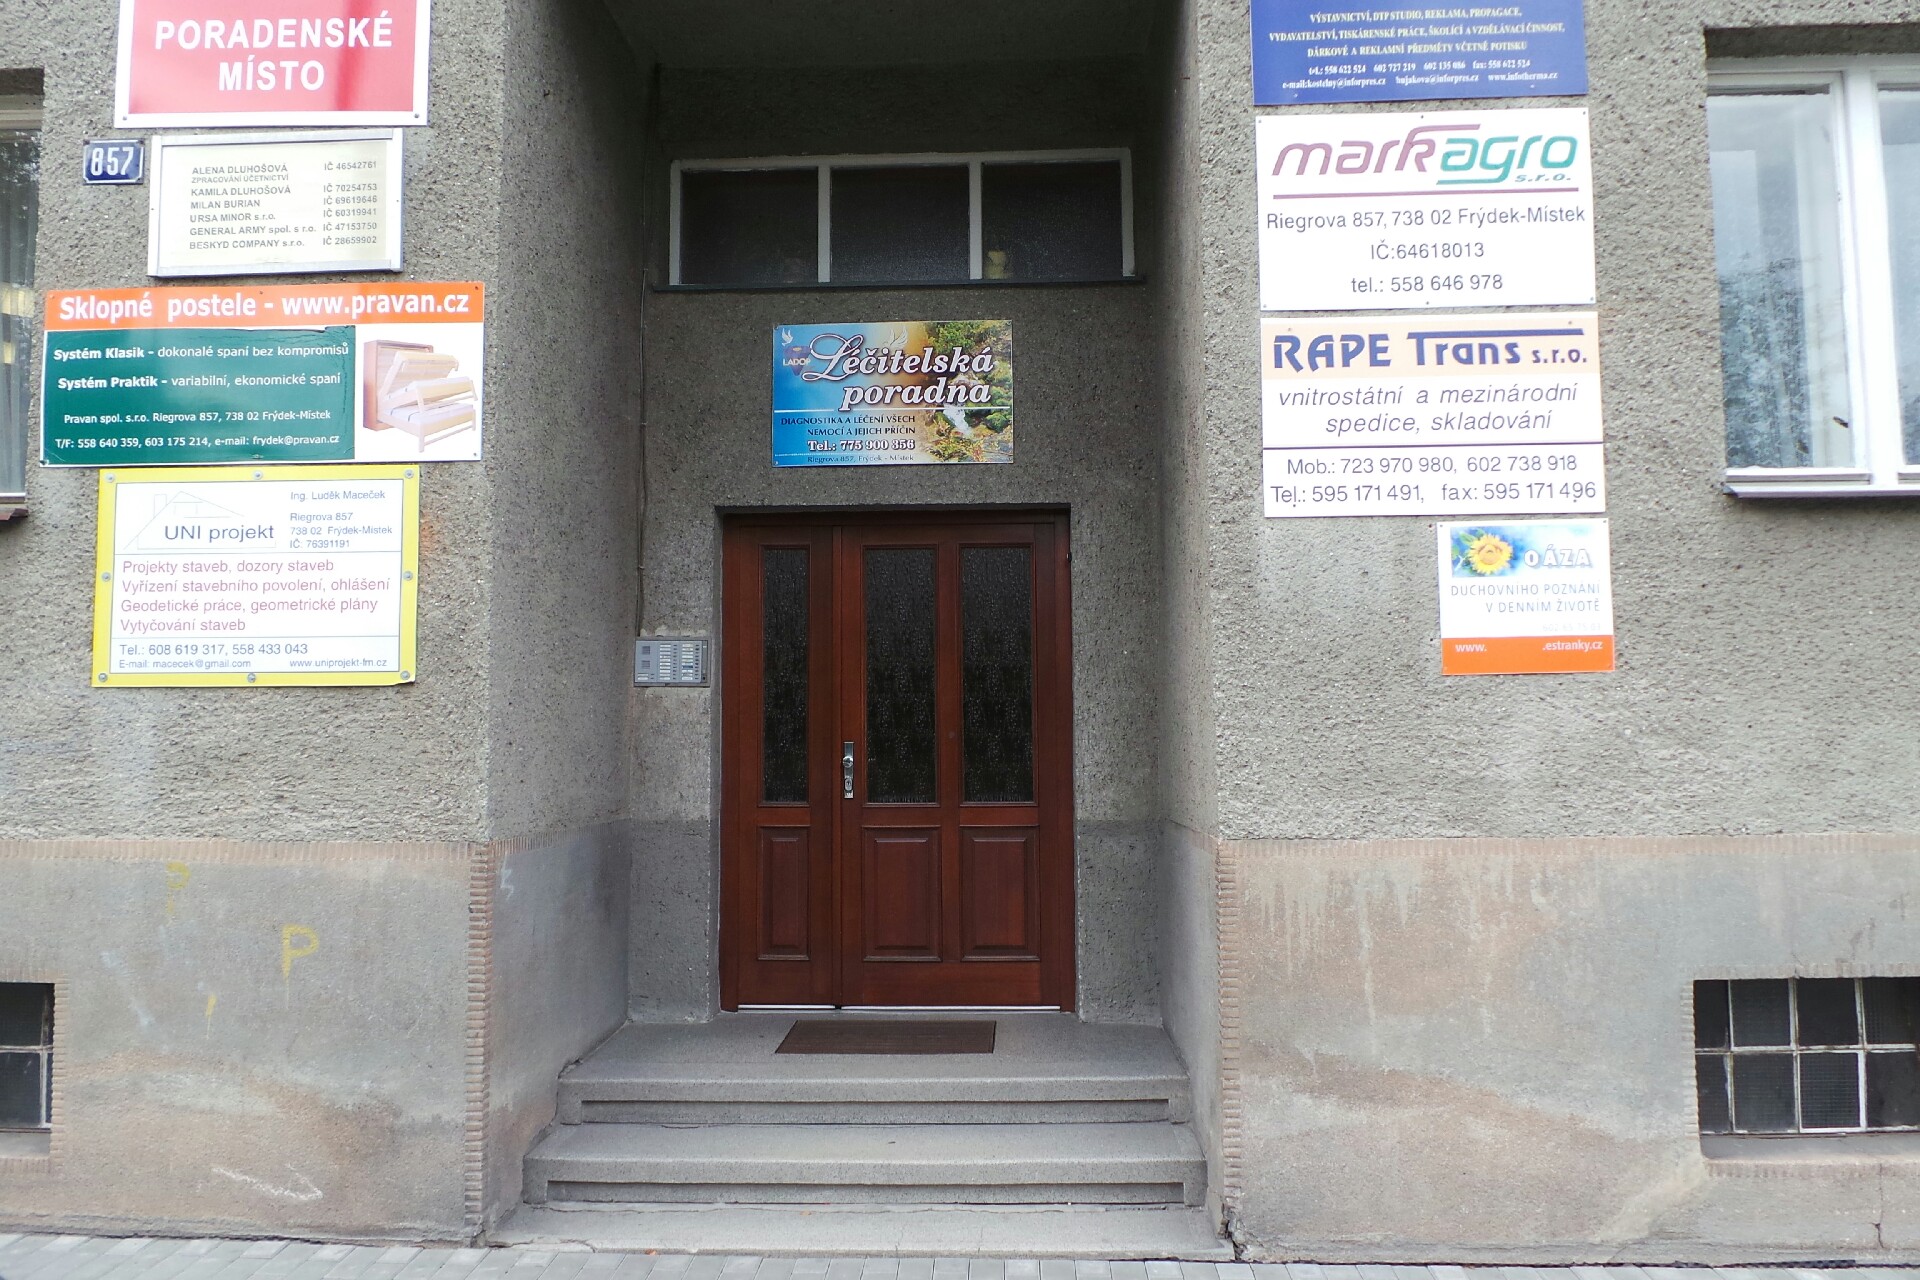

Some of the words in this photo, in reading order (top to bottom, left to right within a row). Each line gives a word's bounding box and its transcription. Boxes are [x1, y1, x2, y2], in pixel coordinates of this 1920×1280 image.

[155, 11, 393, 50] PORADENSKÉ
[218, 55, 325, 91] MÍSTO
[90, 147, 133, 176] 857
[192, 166, 224, 174] ALENA
[228, 163, 287, 173] DLUHOŠOVÁ
[324, 162, 333, 171] IČ
[1515, 174, 1571, 183] s.r.o.
[191, 188, 228, 196] KAMILA
[230, 185, 290, 195] DLUHOŠOVÁ
[324, 185, 333, 193] IČ
[191, 201, 221, 209] MILAN
[224, 200, 260, 208] BURIAN
[324, 197, 333, 205] IČ
[190, 215, 218, 223] URSA
[220, 213, 251, 221] MINOR
[323, 209, 333, 218] IČ
[1267, 212, 1346, 233] Riegrova
[1353, 211, 1387, 229] 857,
[1392, 210, 1424, 227] 738
[1431, 209, 1451, 225] 02
[1458, 206, 1585, 228] Frýdek-Místek
[190, 227, 236, 235] GENERAL
[239, 226, 266, 234] ARMY
[269, 226, 291, 234] spol.
[323, 223, 332, 231] IČ
[190, 241, 229, 249] BESKYD
[232, 240, 280, 248] COMPANY
[323, 237, 332, 245] IČ
[1371, 239, 1484, 260] IČ:64618013
[1352, 276, 1383, 293] tel.:
[1391, 276, 1424, 292] 558
[1431, 275, 1463, 291] 646
[1470, 274, 1503, 290] 978
[59, 292, 152, 320] Sklopné
[168, 288, 256, 321] postele
[282, 293, 469, 319] www.pravan.cz
[54, 347, 101, 363] Systém
[105, 346, 145, 358] Klasik
[158, 345, 213, 358] dokonalé
[217, 345, 249, 361] spaní
[253, 345, 273, 357] bez
[277, 342, 348, 359] kompromisů
[802, 334, 993, 381] Léčitelská
[1274, 333, 1391, 373] RAPE
[1407, 328, 1521, 366] Trans
[1532, 348, 1588, 364] s.r.o.
[58, 376, 106, 391] Systém
[110, 375, 157, 388] Praktik
[171, 374, 231, 388] variabilní,
[235, 372, 305, 387] ekonomické
[309, 373, 341, 388] spaní
[839, 377, 991, 411] poradna
[1279, 387, 1402, 406] vnitrostátní
[1417, 390, 1428, 404] a
[1439, 383, 1578, 403] mezinárodní
[64, 414, 97, 424] Pravan
[100, 412, 122, 426] spol.
[153, 411, 196, 424] Riegrova
[200, 412, 222, 424] 857,
[225, 412, 242, 422] 738
[246, 411, 259, 421] 02
[262, 408, 330, 423] Frýdek-Místek
[781, 417, 843, 425] DIAGNOSTIKA
[854, 415, 884, 423] LÉČENÍ
[887, 415, 915, 423] VŠECH
[1326, 414, 1421, 437] spedice,
[1431, 410, 1552, 431] skladování
[808, 427, 845, 435] NEMOCÍ
[855, 427, 881, 435] JEJICH
[885, 426, 915, 434] PŘÍČIN
[55, 438, 74, 449] T/F:
[78, 438, 96, 448] 558
[100, 438, 118, 448] 640
[122, 437, 142, 449] 359,
[145, 437, 163, 447] 603
[167, 437, 185, 447] 175
[189, 436, 211, 448] 214,
[215, 436, 250, 446] e-mail:
[253, 434, 339, 448] frydek@pravan.cz
[808, 441, 836, 451] Tel.:
[840, 440, 862, 450] 775
[866, 440, 888, 450] 900
[892, 439, 915, 449] 356
[1288, 458, 1334, 475] Mob.:
[1340, 458, 1374, 474] 723
[1380, 458, 1412, 473] 970
[1419, 457, 1457, 475] 980,
[1467, 456, 1501, 473] 602
[1508, 455, 1541, 471] 738
[1548, 455, 1577, 471] 918
[291, 491, 307, 502] Ing.
[311, 490, 340, 500] Luděk
[344, 490, 385, 499] Maceček
[1271, 486, 1305, 502] Tel.:
[1312, 486, 1347, 502] 595
[1355, 485, 1384, 501] 171
[1387, 484, 1424, 504] 491,
[1442, 484, 1478, 500] fax:
[1484, 483, 1519, 500] 595
[1526, 482, 1553, 499] 171
[1559, 481, 1596, 499] 496
[290, 512, 333, 524] Riegrova
[335, 512, 353, 521] 857
[164, 525, 201, 541] UNI
[209, 525, 275, 543] projekt
[290, 527, 307, 535] 738
[311, 526, 321, 535] 02
[123, 561, 178, 575] Projekty
[183, 559, 232, 574] staveb,
[237, 560, 283, 574] dozory
[288, 560, 334, 572] staveb
[122, 579, 177, 594] Vyřízení
[182, 579, 258, 592] stavebního
[263, 579, 326, 594] povolení,
[331, 578, 389, 591] ohlášení
[1451, 582, 1538, 596] DUCHOVNÍHO
[1544, 580, 1600, 595] POZNÁNÍ
[121, 598, 198, 613] Geodetické
[204, 599, 246, 614] práce,
[251, 598, 335, 614] geometrické
[340, 598, 378, 613] plány
[1486, 603, 1493, 613] V
[1499, 599, 1551, 613] DENNÍM
[1557, 598, 1600, 611] ŽIVOTĚ
[121, 618, 196, 634] Vytyčování
[200, 618, 245, 631] staveb
[120, 645, 145, 655] Tel.:
[149, 645, 171, 655] 608
[175, 645, 198, 655] 619
[202, 644, 228, 656] 317,
[232, 644, 254, 654] 558
[259, 644, 281, 654] 433
[285, 644, 307, 654] 043
[1455, 644, 1487, 652] www.
[1543, 640, 1603, 652] .estranky.cz
[281, 924, 319, 985] P
